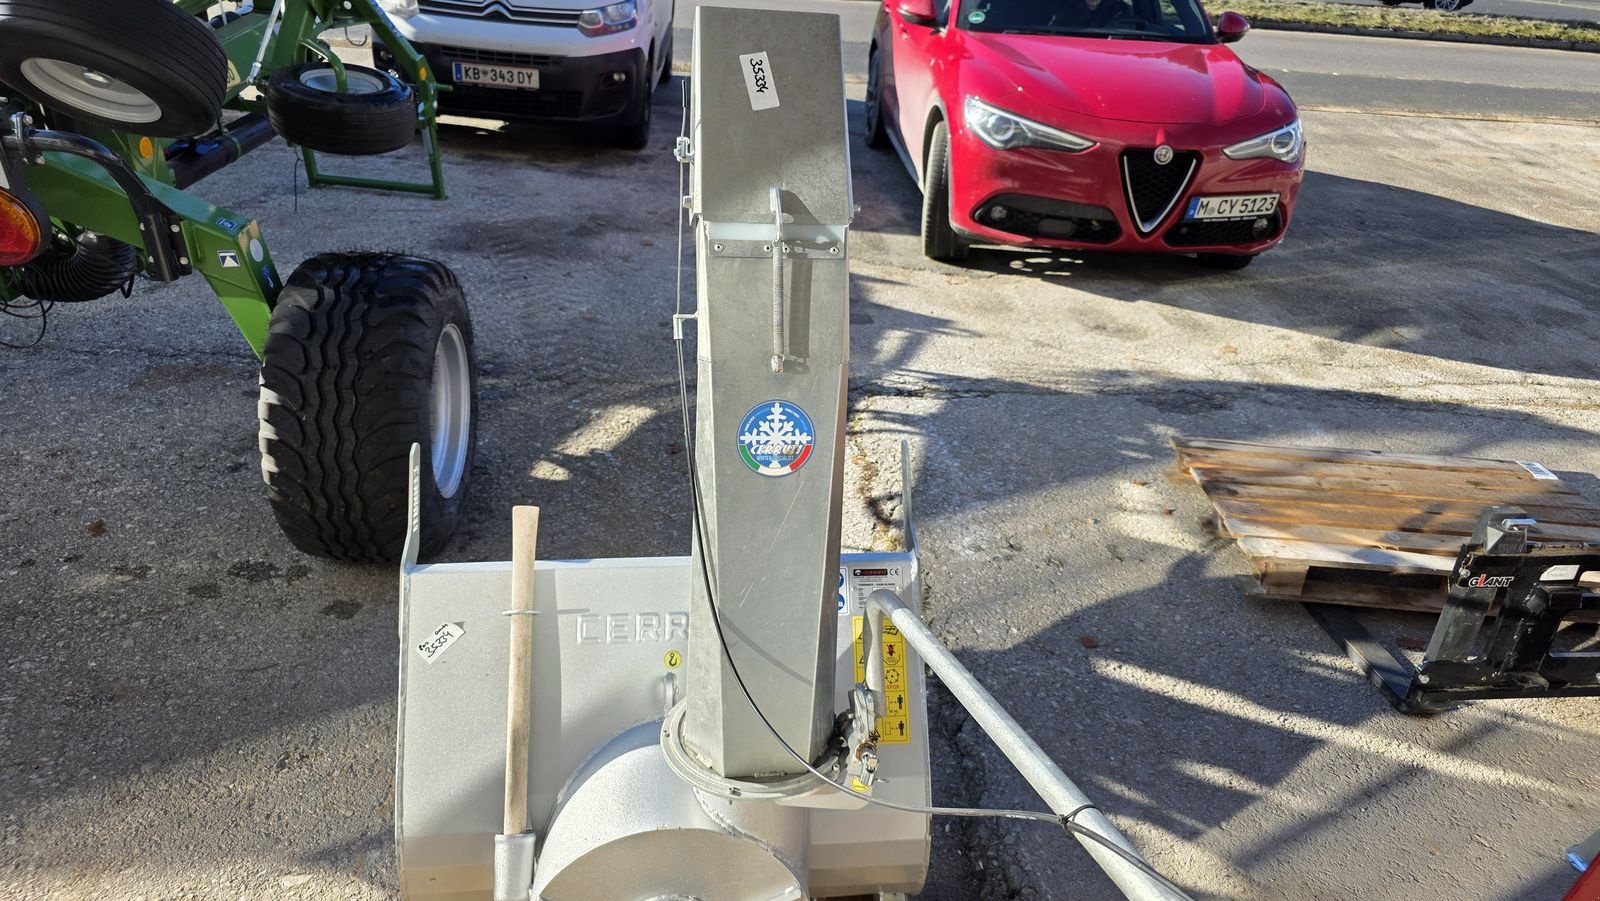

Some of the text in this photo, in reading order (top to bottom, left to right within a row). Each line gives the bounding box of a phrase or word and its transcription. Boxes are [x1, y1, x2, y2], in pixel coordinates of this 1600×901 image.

[464, 66, 533, 85] KB 343 DY
[750, 58, 769, 93] 35334
[1197, 197, 1277, 215] M CY 5123
[1468, 574, 1514, 588] GIANT
[577, 611, 688, 644] CERR
